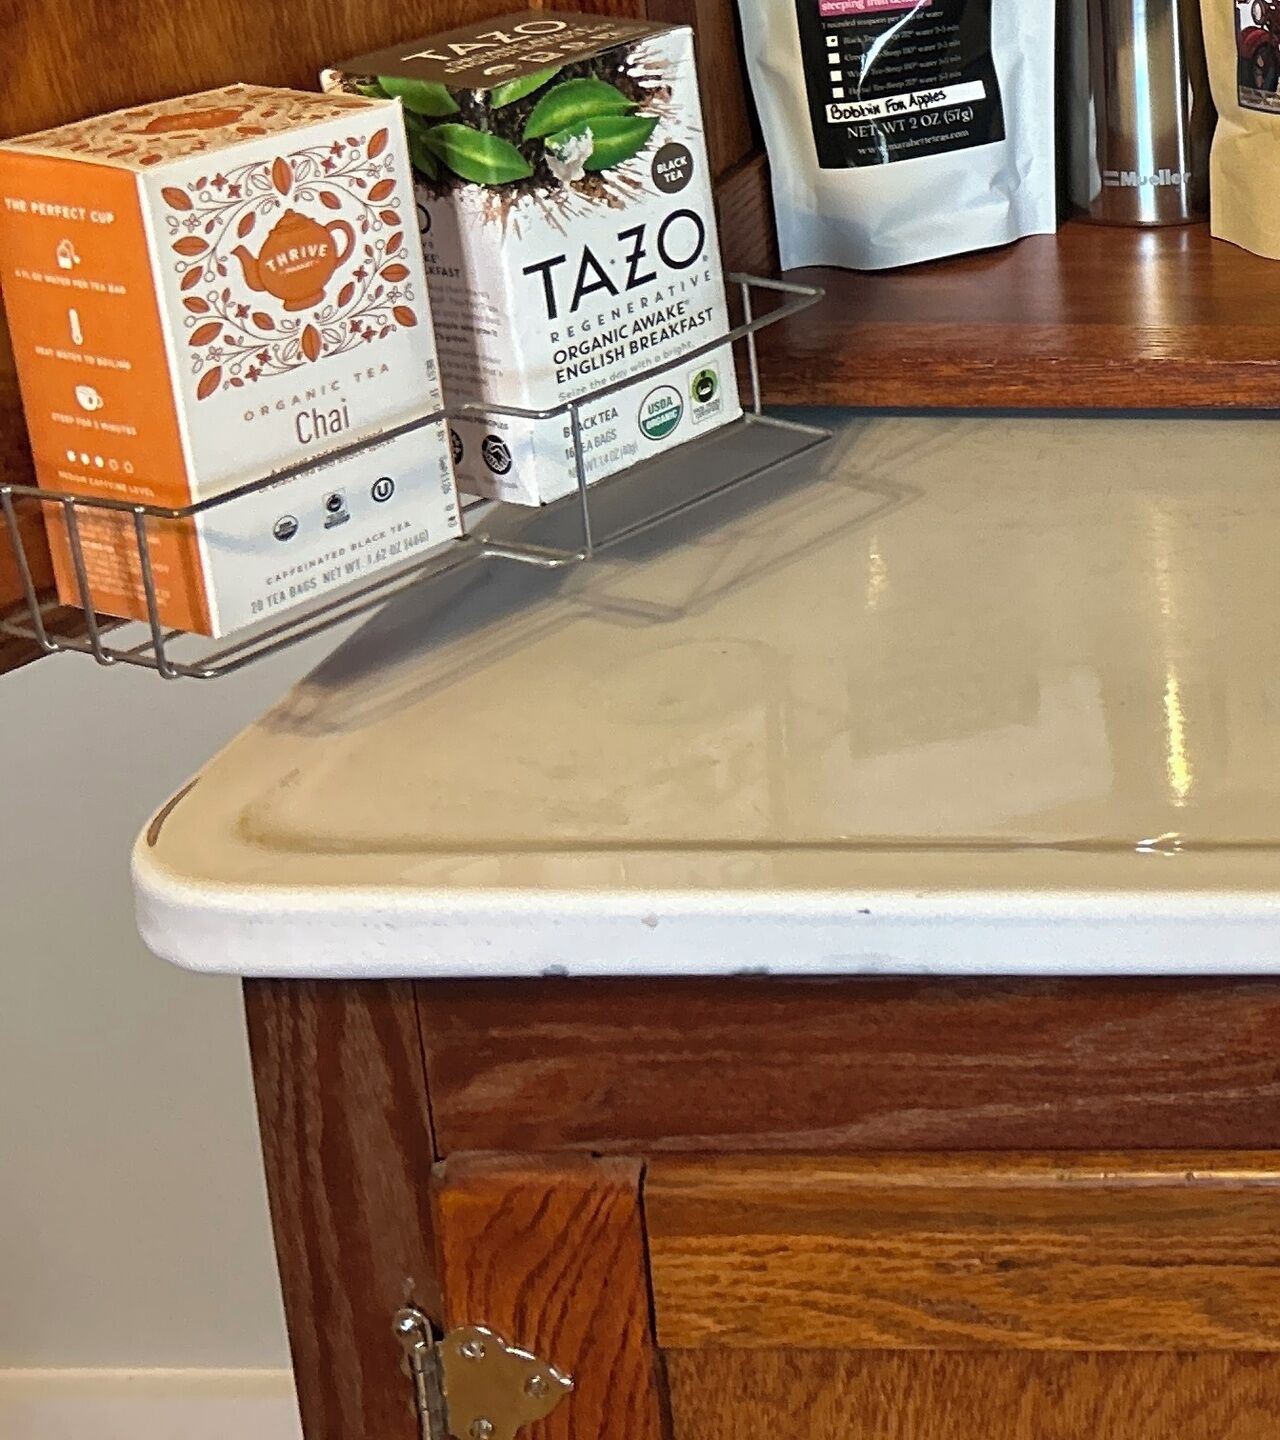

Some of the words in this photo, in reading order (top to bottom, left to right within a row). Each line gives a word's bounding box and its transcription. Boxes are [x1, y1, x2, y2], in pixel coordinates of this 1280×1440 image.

[401, 19, 567, 61] TAZO
[909, 90, 947, 110] Apples
[846, 124, 877, 139] NET
[881, 120, 906, 135] WT
[909, 117, 918, 129] 2
[920, 112, 942, 126] OZ
[943, 106, 975, 125] (57g)
[656, 156, 688, 174] BLACK
[664, 170, 685, 183] TEA
[4, 198, 28, 212] THE
[30, 201, 87, 220] PERFECT
[89, 210, 116, 225] CUP
[265, 243, 329, 272] THRIVE
[522, 208, 705, 320] TAZO
[550, 270, 712, 344] REGENERATIVE
[552, 324, 629, 365] ORGANIC
[631, 301, 686, 336] AWAKE
[555, 345, 626, 385] ENGLISH
[628, 307, 714, 356] BREAKFAST
[243, 379, 342, 422] ORGANIC
[353, 363, 390, 384] TEA
[558, 386, 588, 402] Seize
[647, 396, 674, 415] USDA
[295, 397, 351, 444] Chai
[562, 415, 598, 439] BACK
[598, 407, 619, 423] TEA
[594, 428, 618, 448] BAGS
[266, 548, 346, 586] CAFFEINATED
[350, 531, 387, 551] BLACK
[390, 521, 412, 535] TEA
[250, 598, 265, 614] 20
[267, 590, 287, 607] TEA
[289, 578, 318, 599] BAGS
[322, 567, 342, 584] NET
